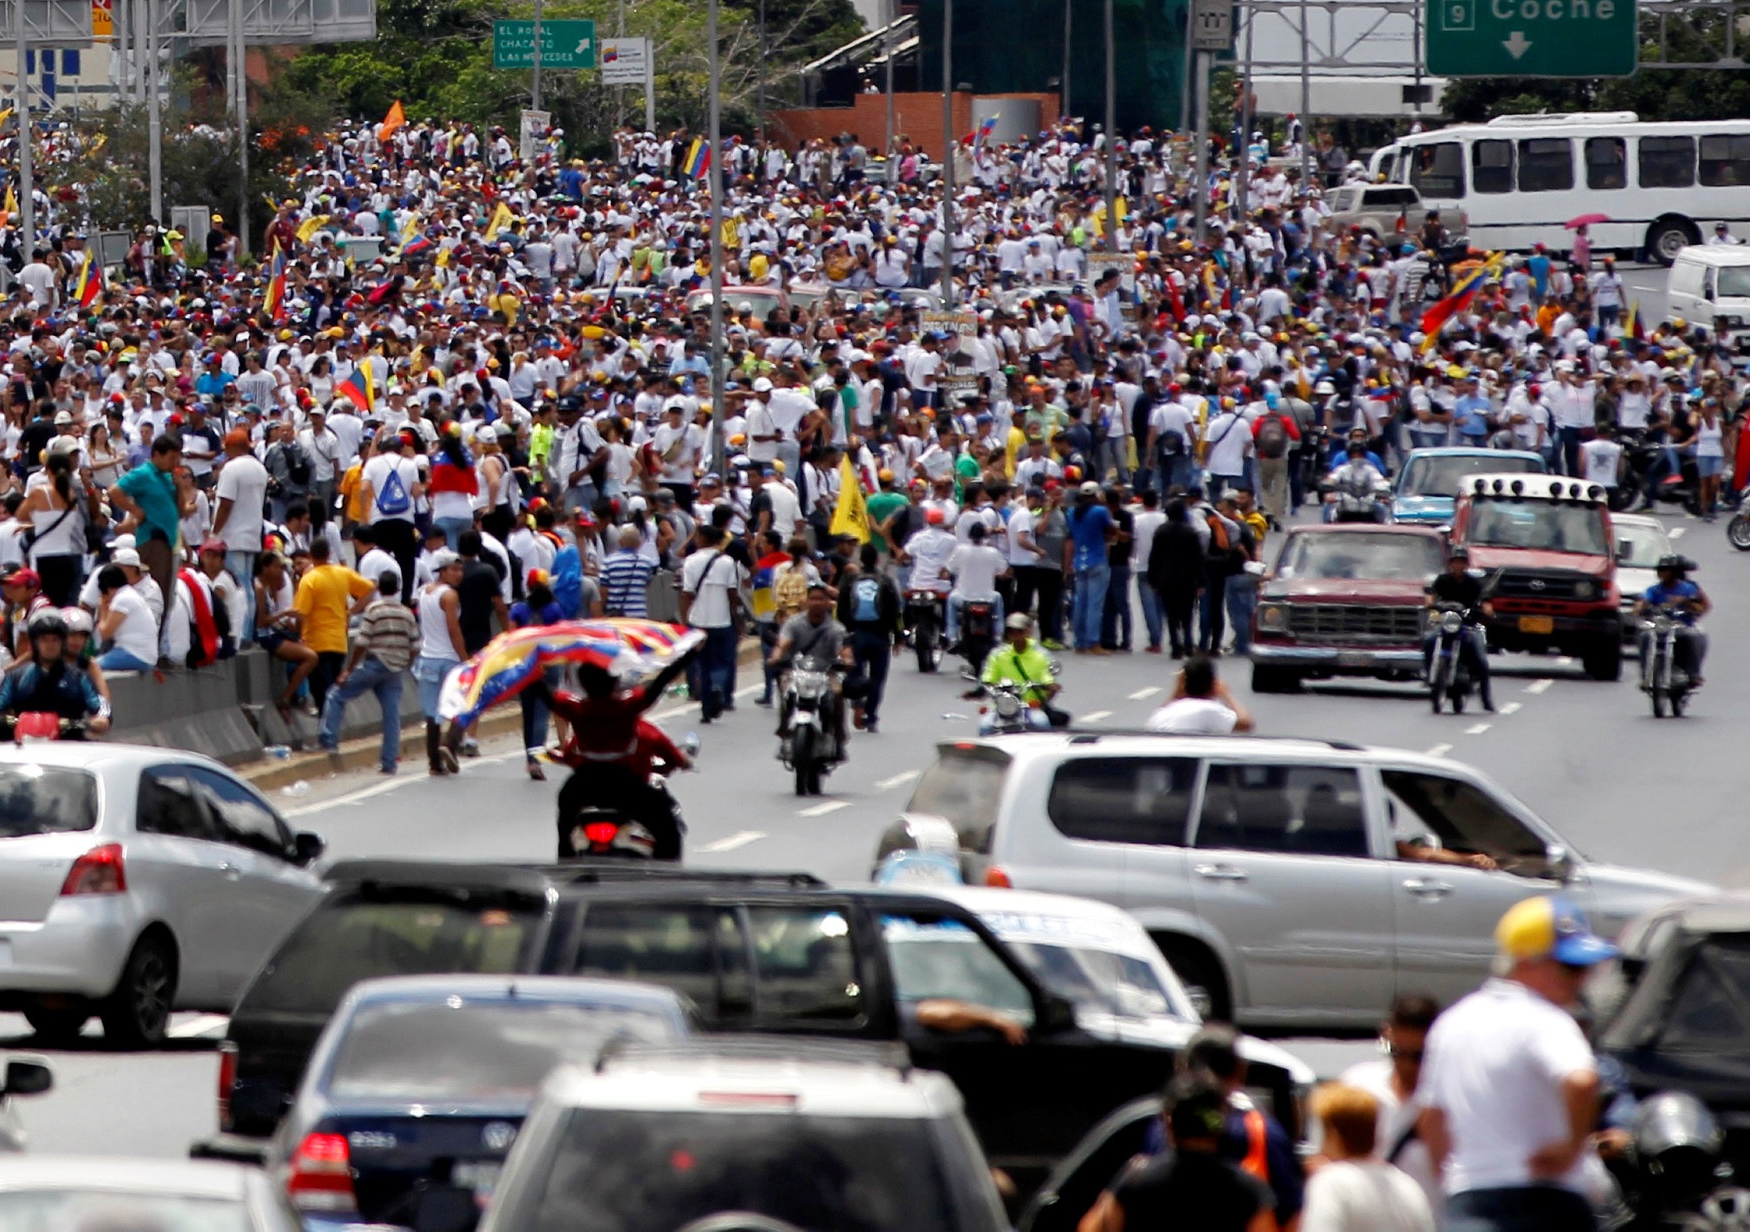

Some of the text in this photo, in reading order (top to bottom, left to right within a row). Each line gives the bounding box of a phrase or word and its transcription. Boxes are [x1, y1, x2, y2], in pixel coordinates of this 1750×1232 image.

[1452, 5, 1465, 22] 9
[500, 27, 513, 36] EL
[500, 40, 554, 49] CHACATO
[500, 53, 520, 61] LAS
